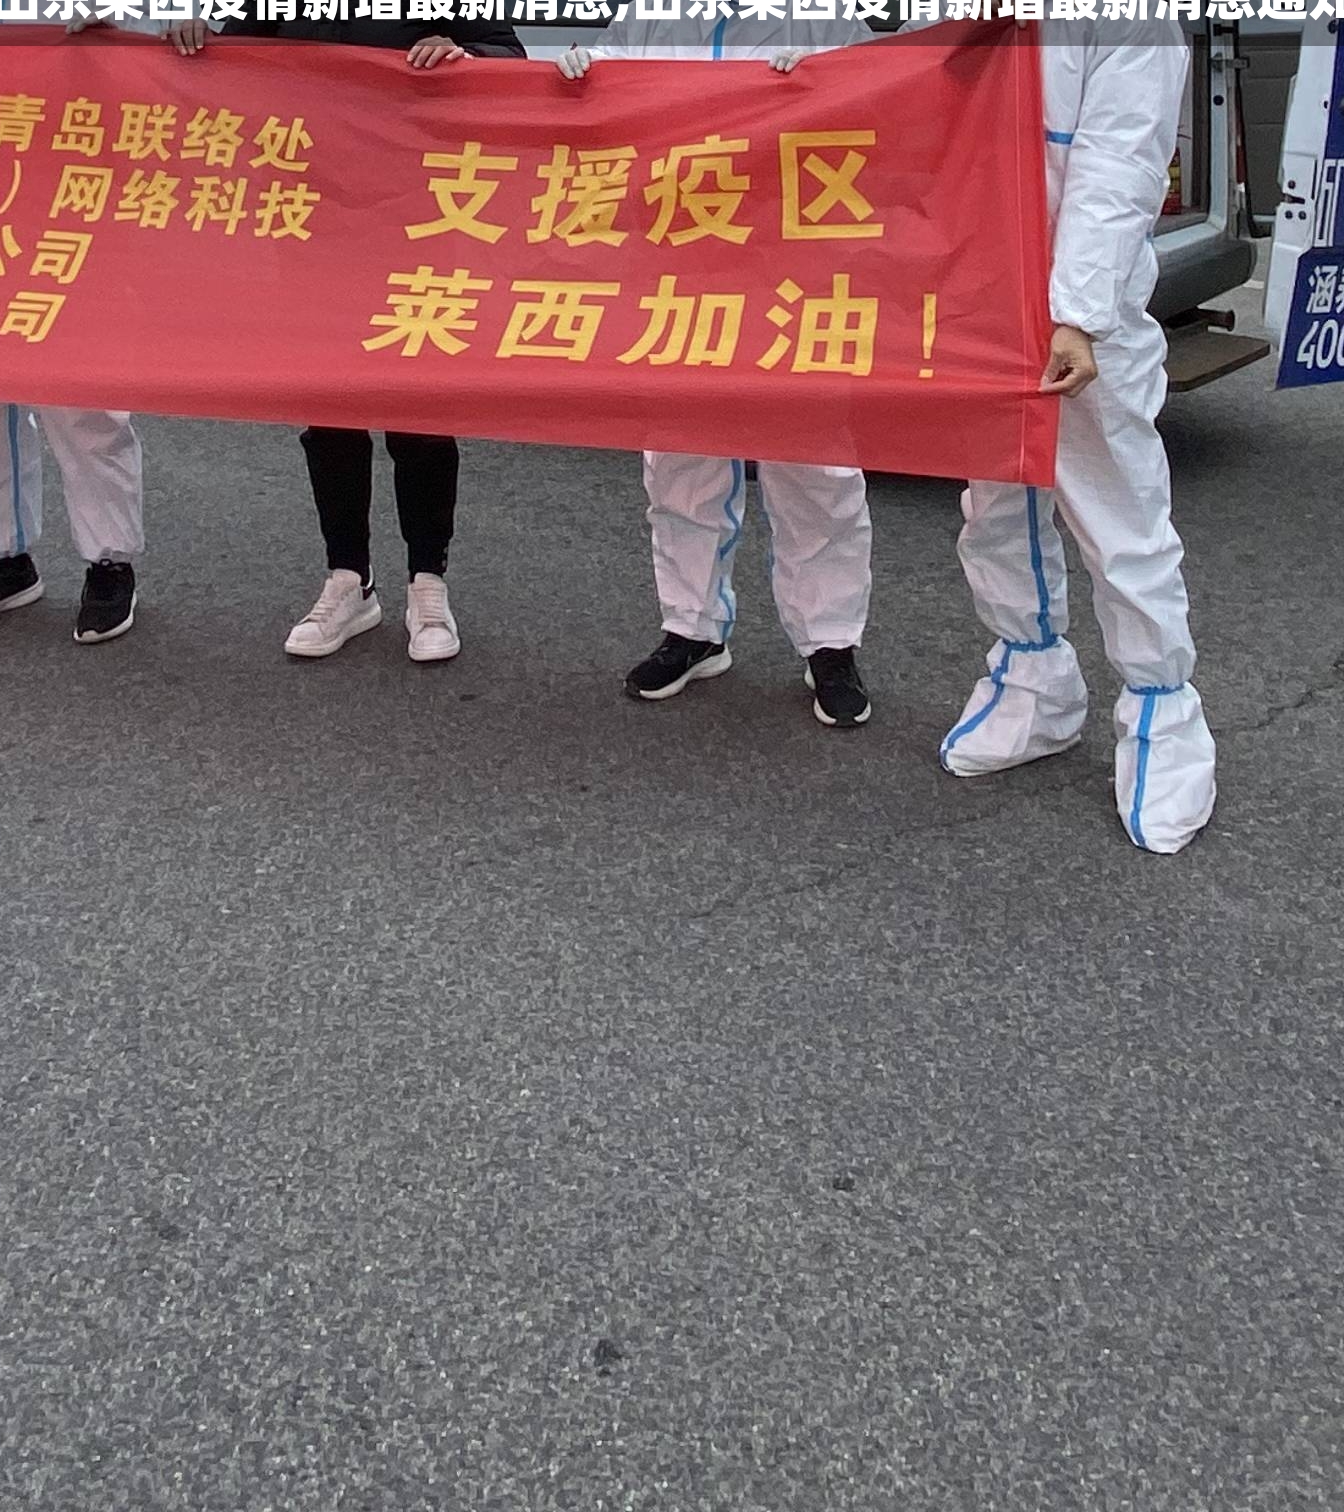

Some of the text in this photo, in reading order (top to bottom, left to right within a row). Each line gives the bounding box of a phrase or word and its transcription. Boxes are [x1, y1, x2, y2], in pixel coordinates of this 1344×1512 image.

[403, 128, 885, 248] 支援疫区
[361, 265, 938, 379] 莱西加油！
